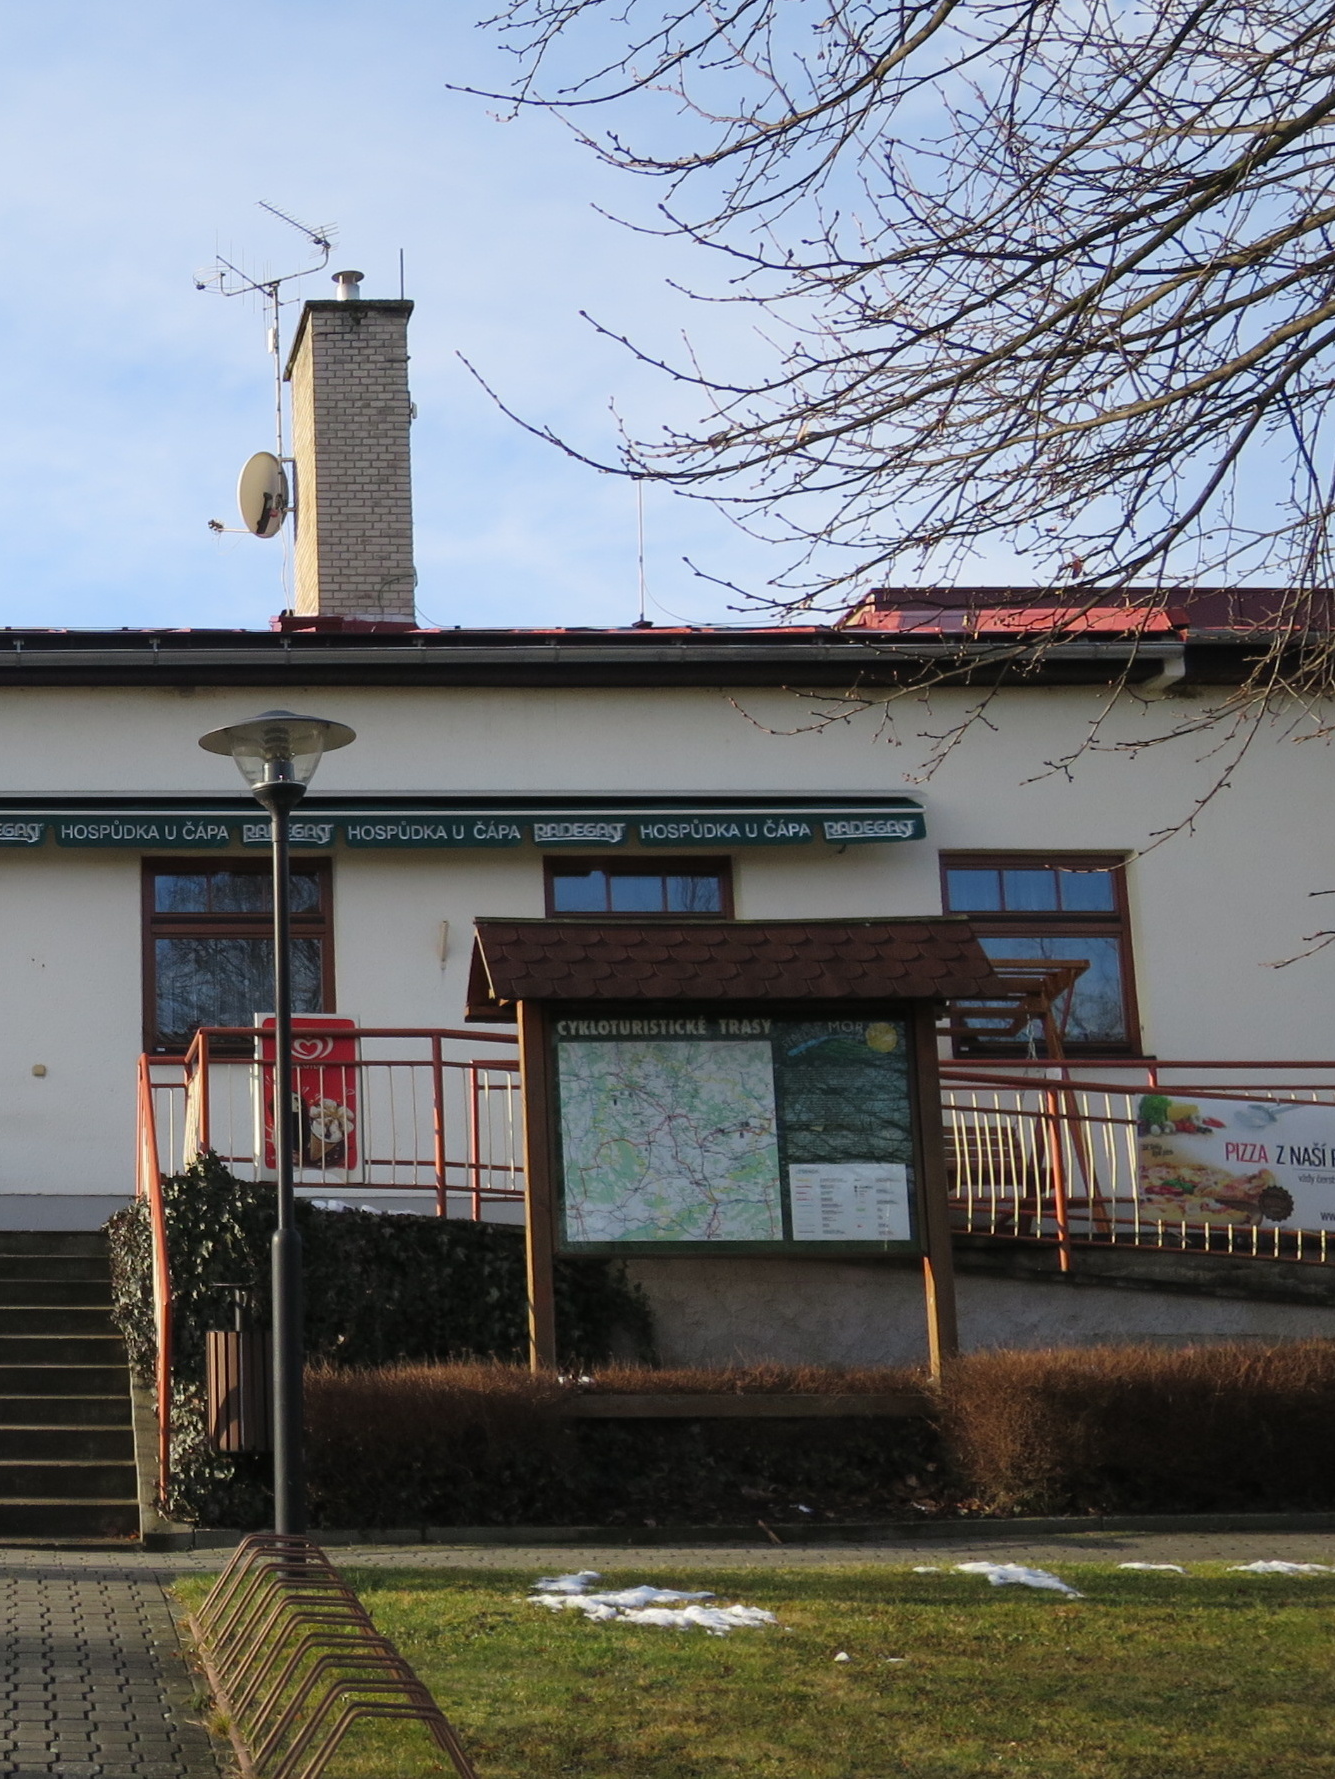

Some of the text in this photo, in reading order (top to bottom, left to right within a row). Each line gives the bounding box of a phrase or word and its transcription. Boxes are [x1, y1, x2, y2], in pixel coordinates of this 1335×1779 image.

[61, 820, 230, 840] HOSPŮDKA U ČÁPA
[243, 823, 334, 844] RAGAST
[348, 820, 521, 840] HOSPŮDKA U ČÁPA
[533, 823, 626, 842] RADEGAST
[640, 818, 812, 839] HOSPŮDKA U ČÁPA
[823, 819, 916, 839] RADEGAST
[557, 1016, 772, 1035] CYKLOTURISTICKÉ TRASY
[1225, 1142, 1268, 1163] PIZZA
[1276, 1145, 1286, 1165] Z
[1290, 1142, 1327, 1167] NAŠÍ
